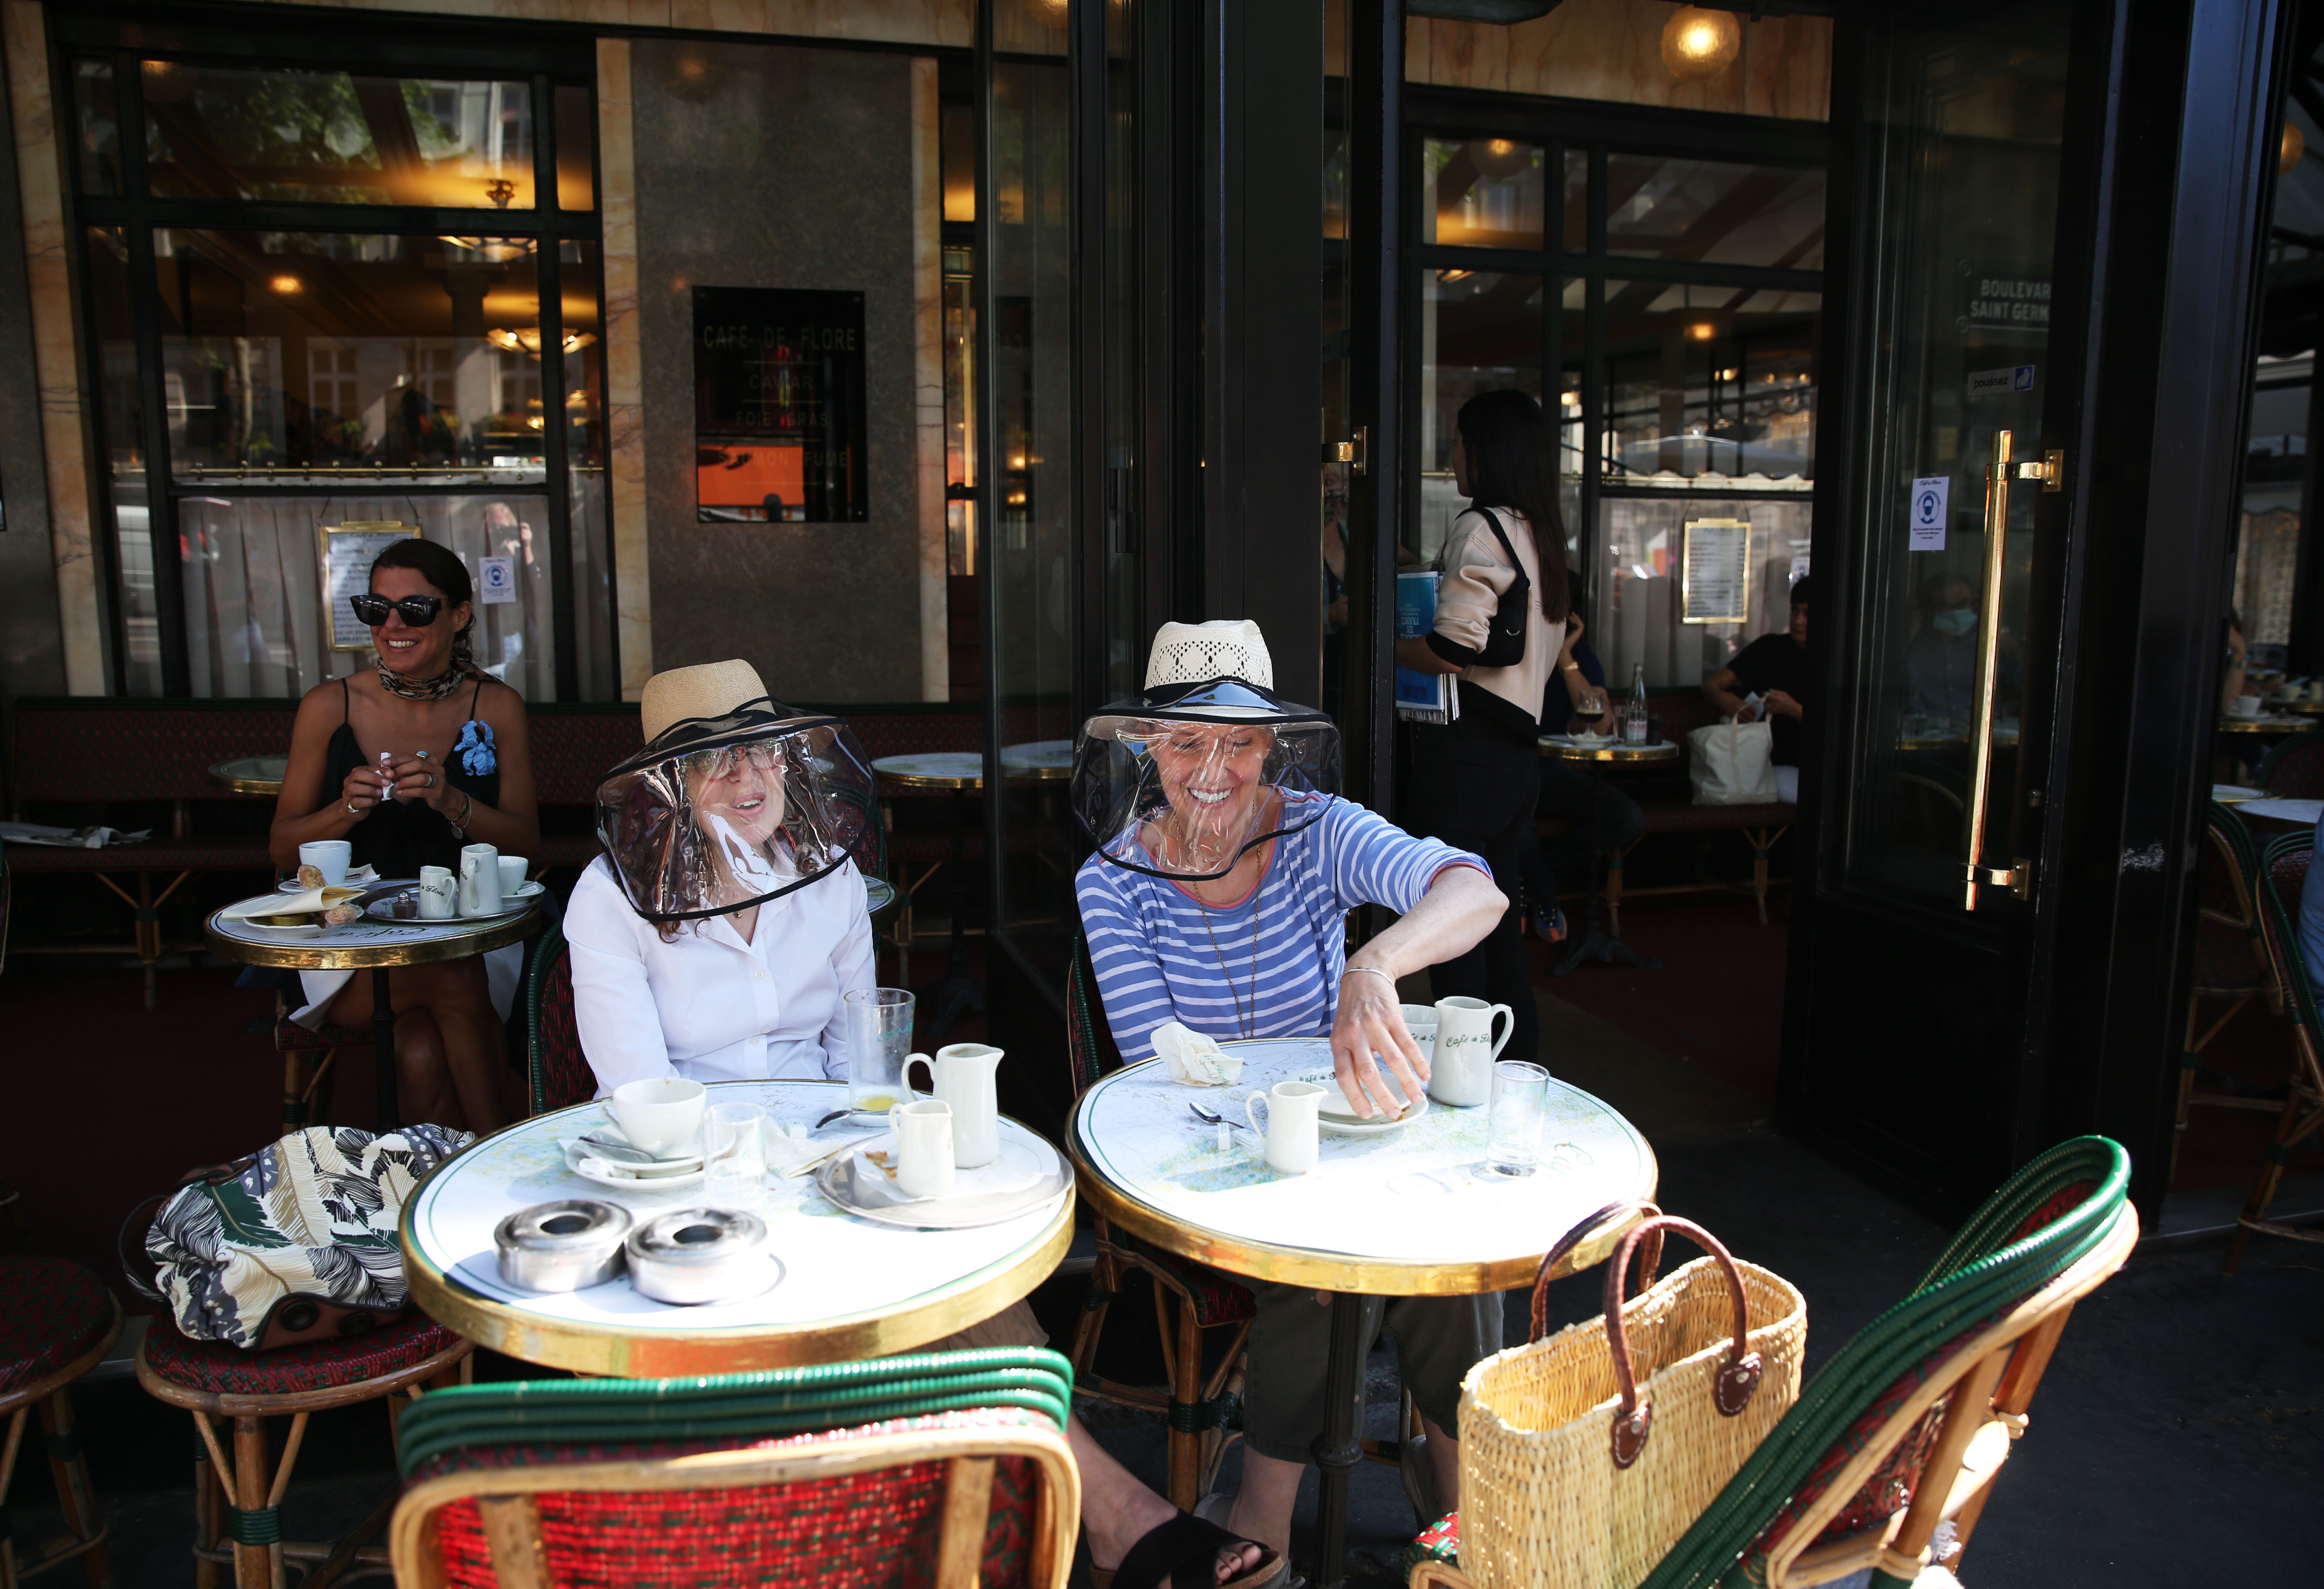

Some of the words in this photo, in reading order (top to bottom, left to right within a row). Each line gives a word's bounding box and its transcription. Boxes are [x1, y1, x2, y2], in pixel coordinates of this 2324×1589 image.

[1970, 299, 2009, 319] SAINT
[764, 326, 786, 349] DE
[801, 327, 856, 351] FLORE
[1973, 377, 2009, 391] poussez
[735, 411, 771, 426] FOIE
[786, 412, 828, 427] GRAS
[1406, 626, 1414, 634] EN
[426, 886, 445, 896] Flore
[1446, 1034, 1469, 1047] Café
[1299, 1074, 1317, 1083] Café
